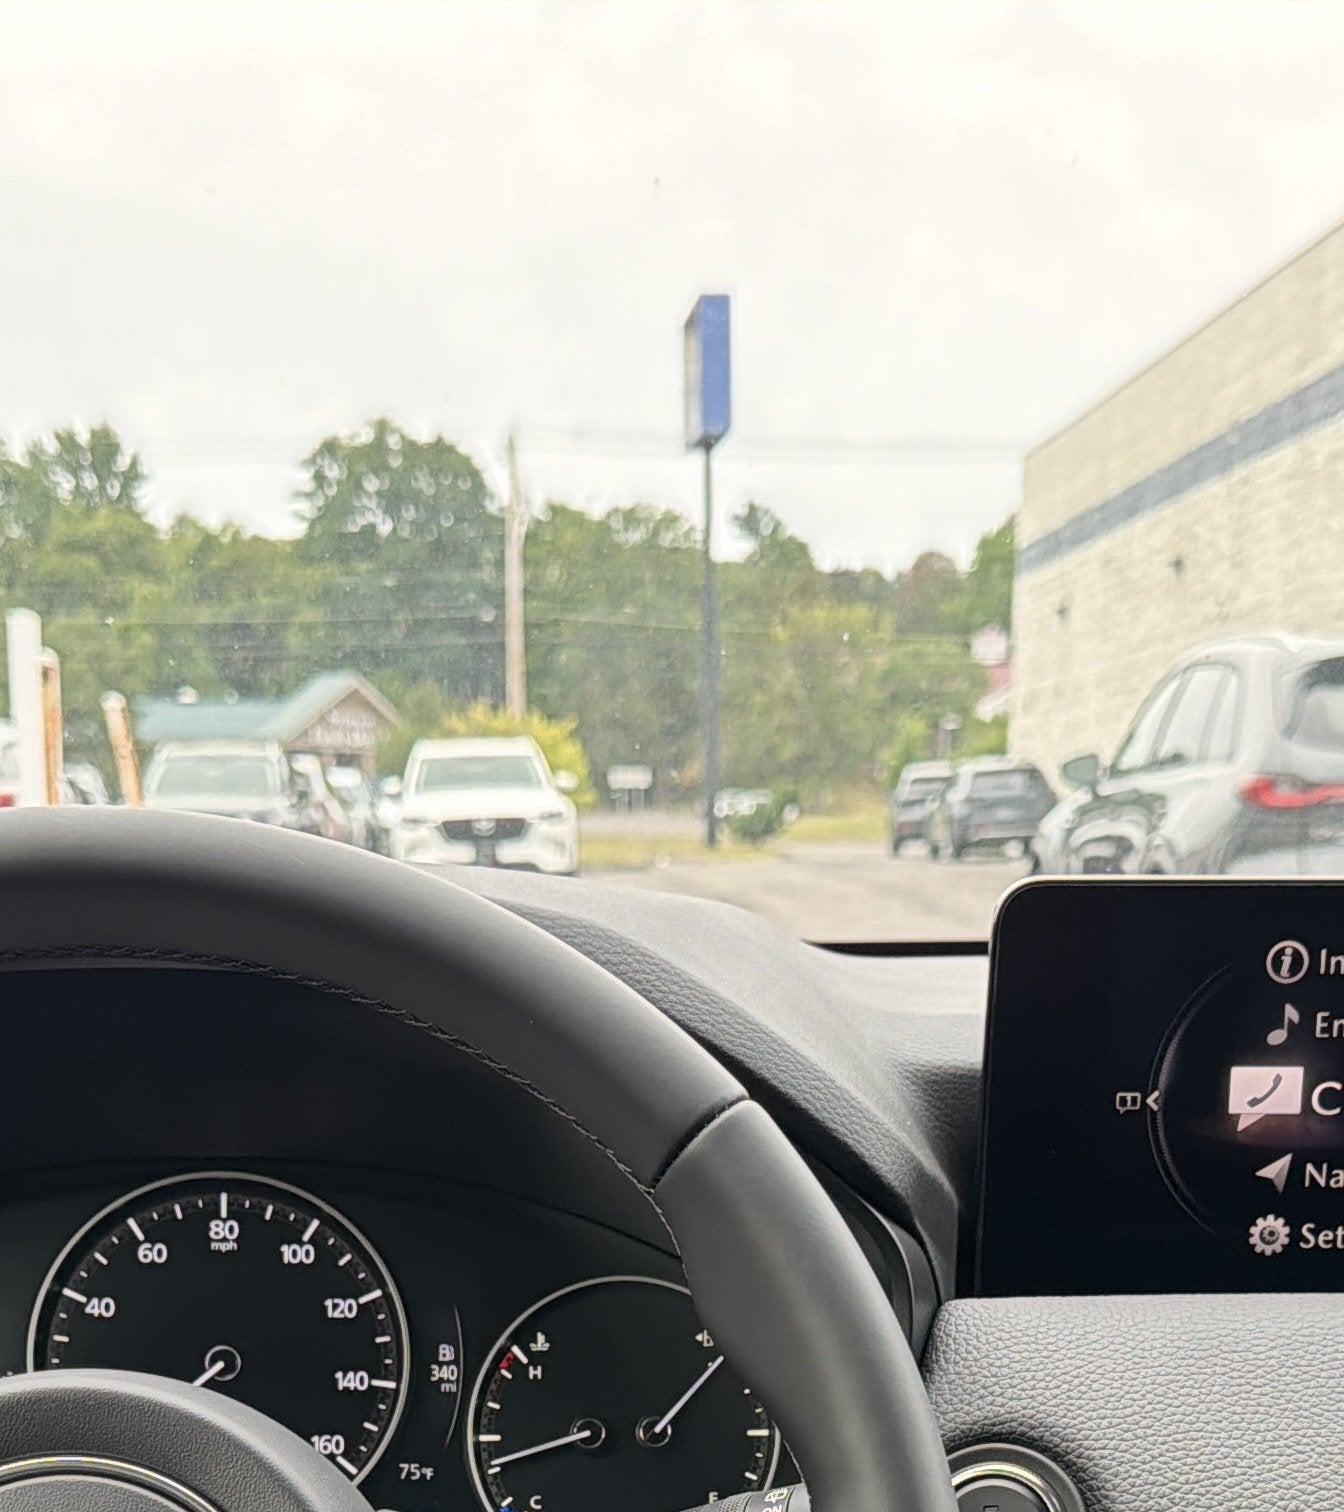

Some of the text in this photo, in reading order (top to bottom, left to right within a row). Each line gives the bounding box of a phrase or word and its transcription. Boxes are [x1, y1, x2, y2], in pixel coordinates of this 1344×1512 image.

[209, 1219, 240, 1241] 80
[137, 1243, 168, 1264] 60
[210, 1240, 238, 1253] mph
[280, 1243, 316, 1265] 100
[84, 1297, 115, 1318] 40
[324, 1298, 358, 1319] 120
[334, 1370, 369, 1391] 140
[430, 1363, 458, 1382] 340
[528, 1365, 543, 1380] H
[440, 1380, 457, 1393] mi
[310, 1434, 345, 1456] 160
[529, 1495, 543, 1510] C
